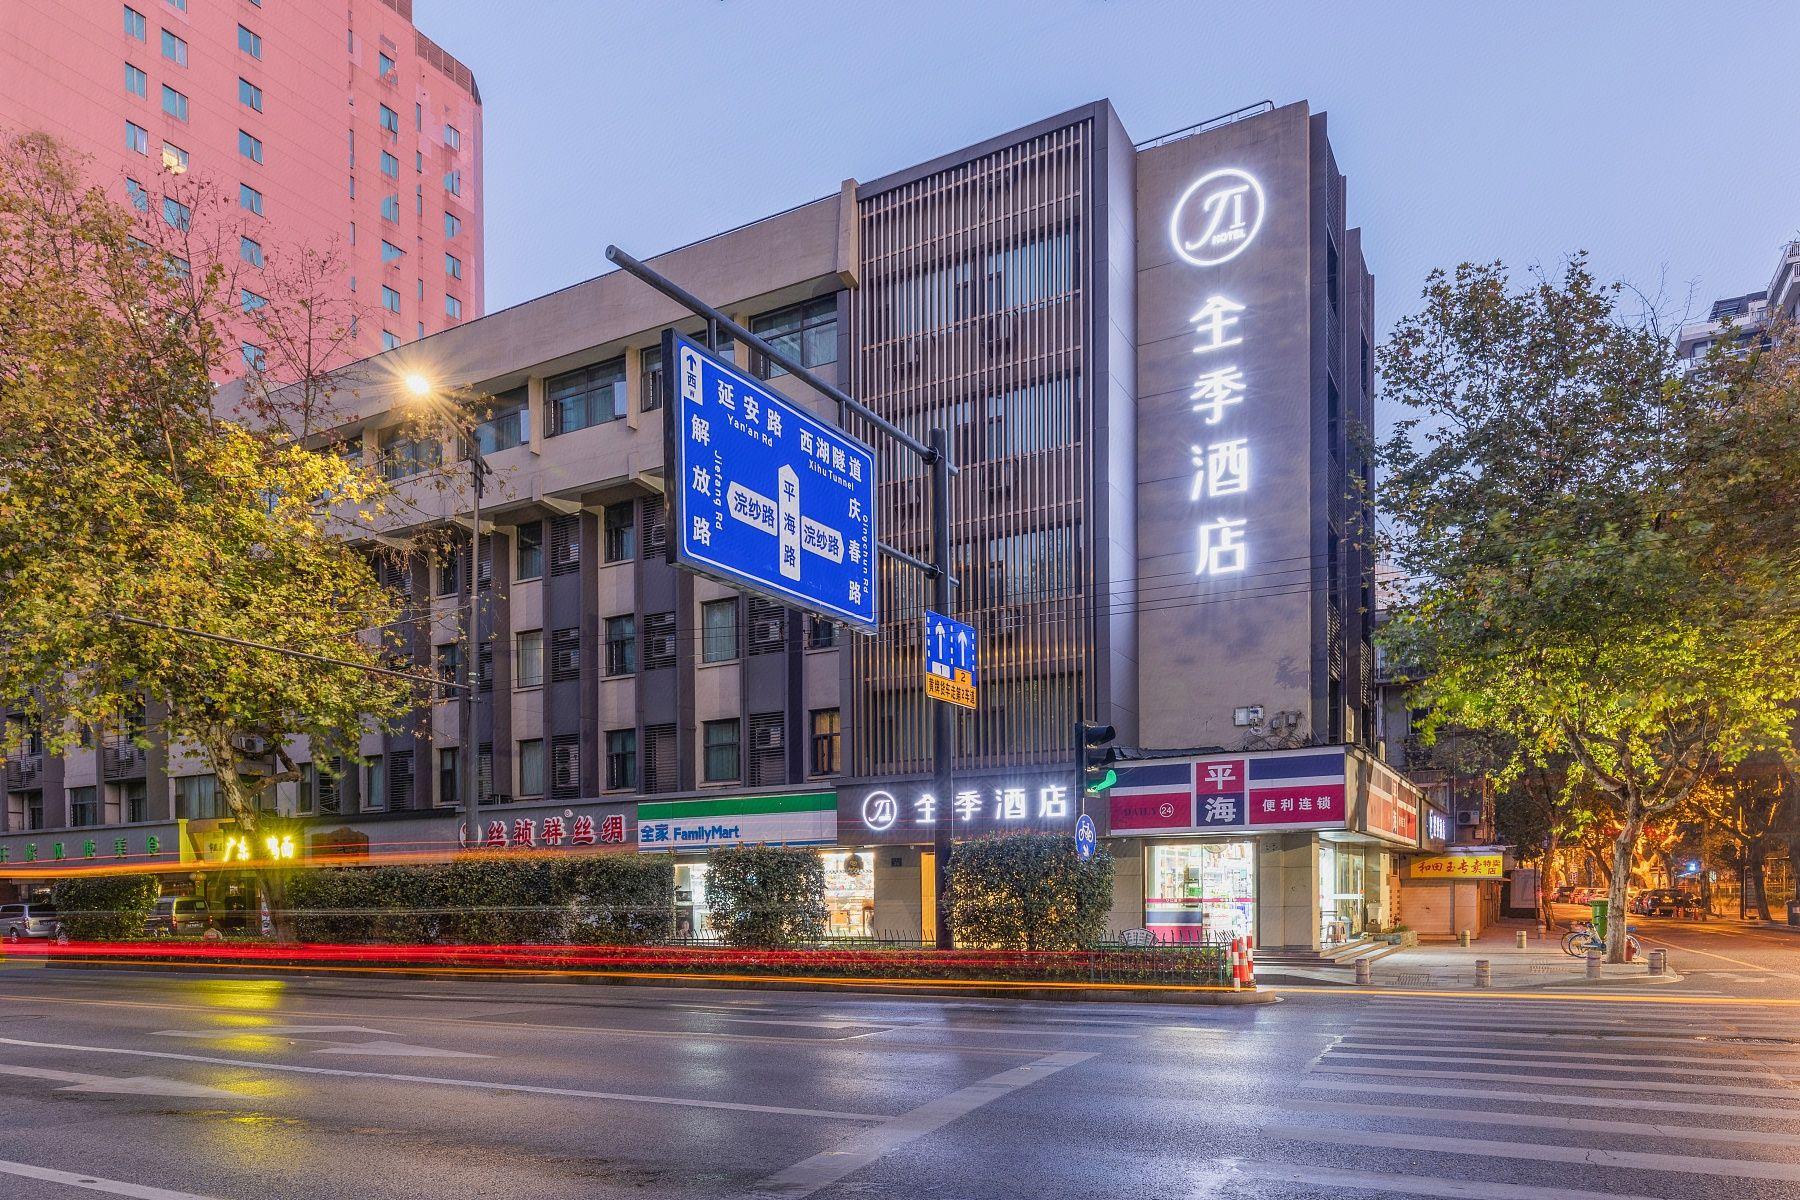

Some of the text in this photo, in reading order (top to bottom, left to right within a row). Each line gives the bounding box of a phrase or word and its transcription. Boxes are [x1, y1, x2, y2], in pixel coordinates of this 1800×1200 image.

[1211, 229, 1246, 245] HOTEL
[686, 371, 697, 389] 西
[717, 378, 782, 439] 延安路
[727, 413, 773, 448] Yan'an Rd
[1189, 294, 1249, 577] 全季酒店
[799, 426, 862, 483] 西湖隧道
[691, 413, 711, 548] 解放路
[713, 450, 723, 531] Jiefang Rd
[808, 459, 855, 491] Xihu Tunnel
[733, 490, 775, 529] 浣纱路
[782, 480, 797, 569] 平海路
[803, 523, 840, 557] 浣纱路
[847, 497, 862, 606] 庆春路
[861, 514, 869, 594] Qingchun Rd
[960, 672, 966, 682] 2
[914, 785, 1067, 823] 全季酒店
[1204, 764, 1237, 823] 平海
[1262, 796, 1331, 812] 便利连锁
[640, 824, 669, 843] 全家
[673, 823, 740, 844] FamilyMart
[1487, 867, 1497, 875] 店
